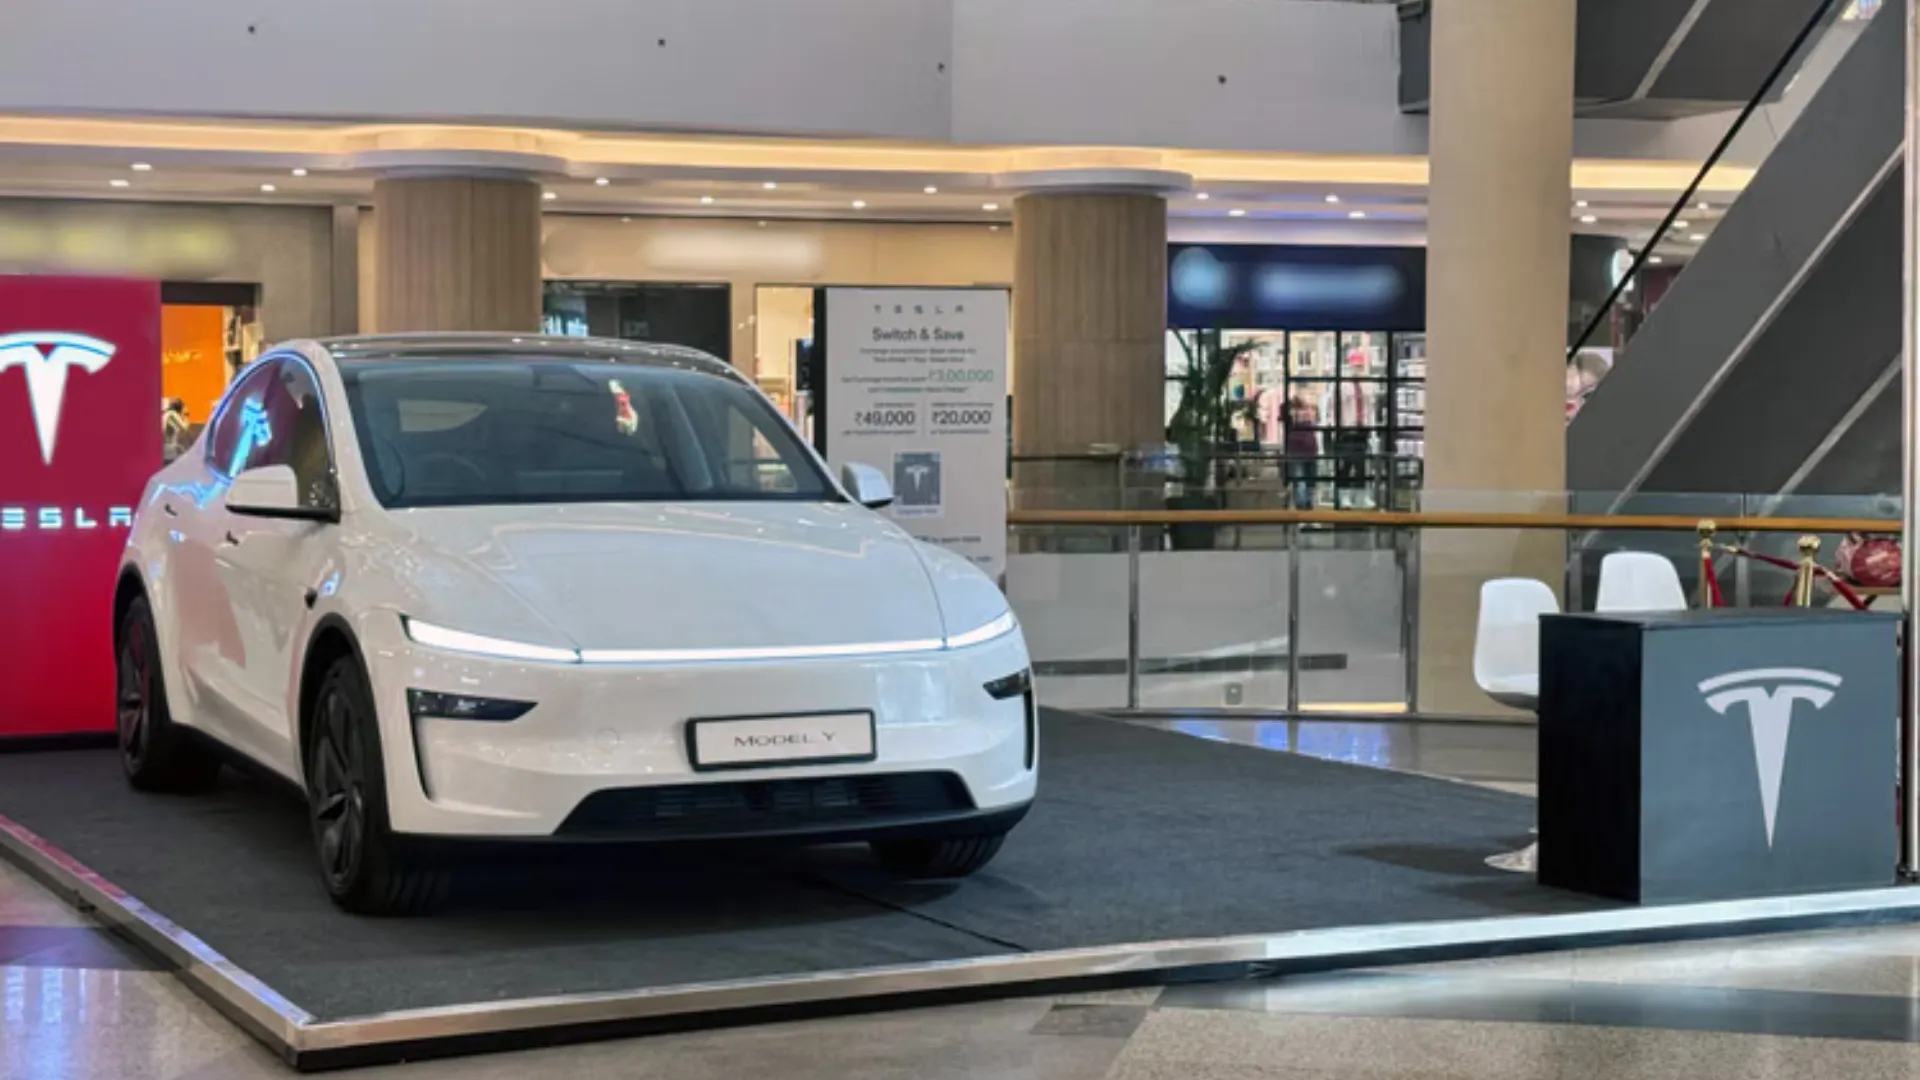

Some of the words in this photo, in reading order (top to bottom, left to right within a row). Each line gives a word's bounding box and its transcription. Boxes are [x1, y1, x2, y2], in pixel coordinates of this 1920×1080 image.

[874, 305, 964, 314] TESLA
[872, 327, 917, 341] Switch
[919, 328, 930, 341] &
[934, 327, 964, 341] Save
[1, 507, 131, 528] ESLA
